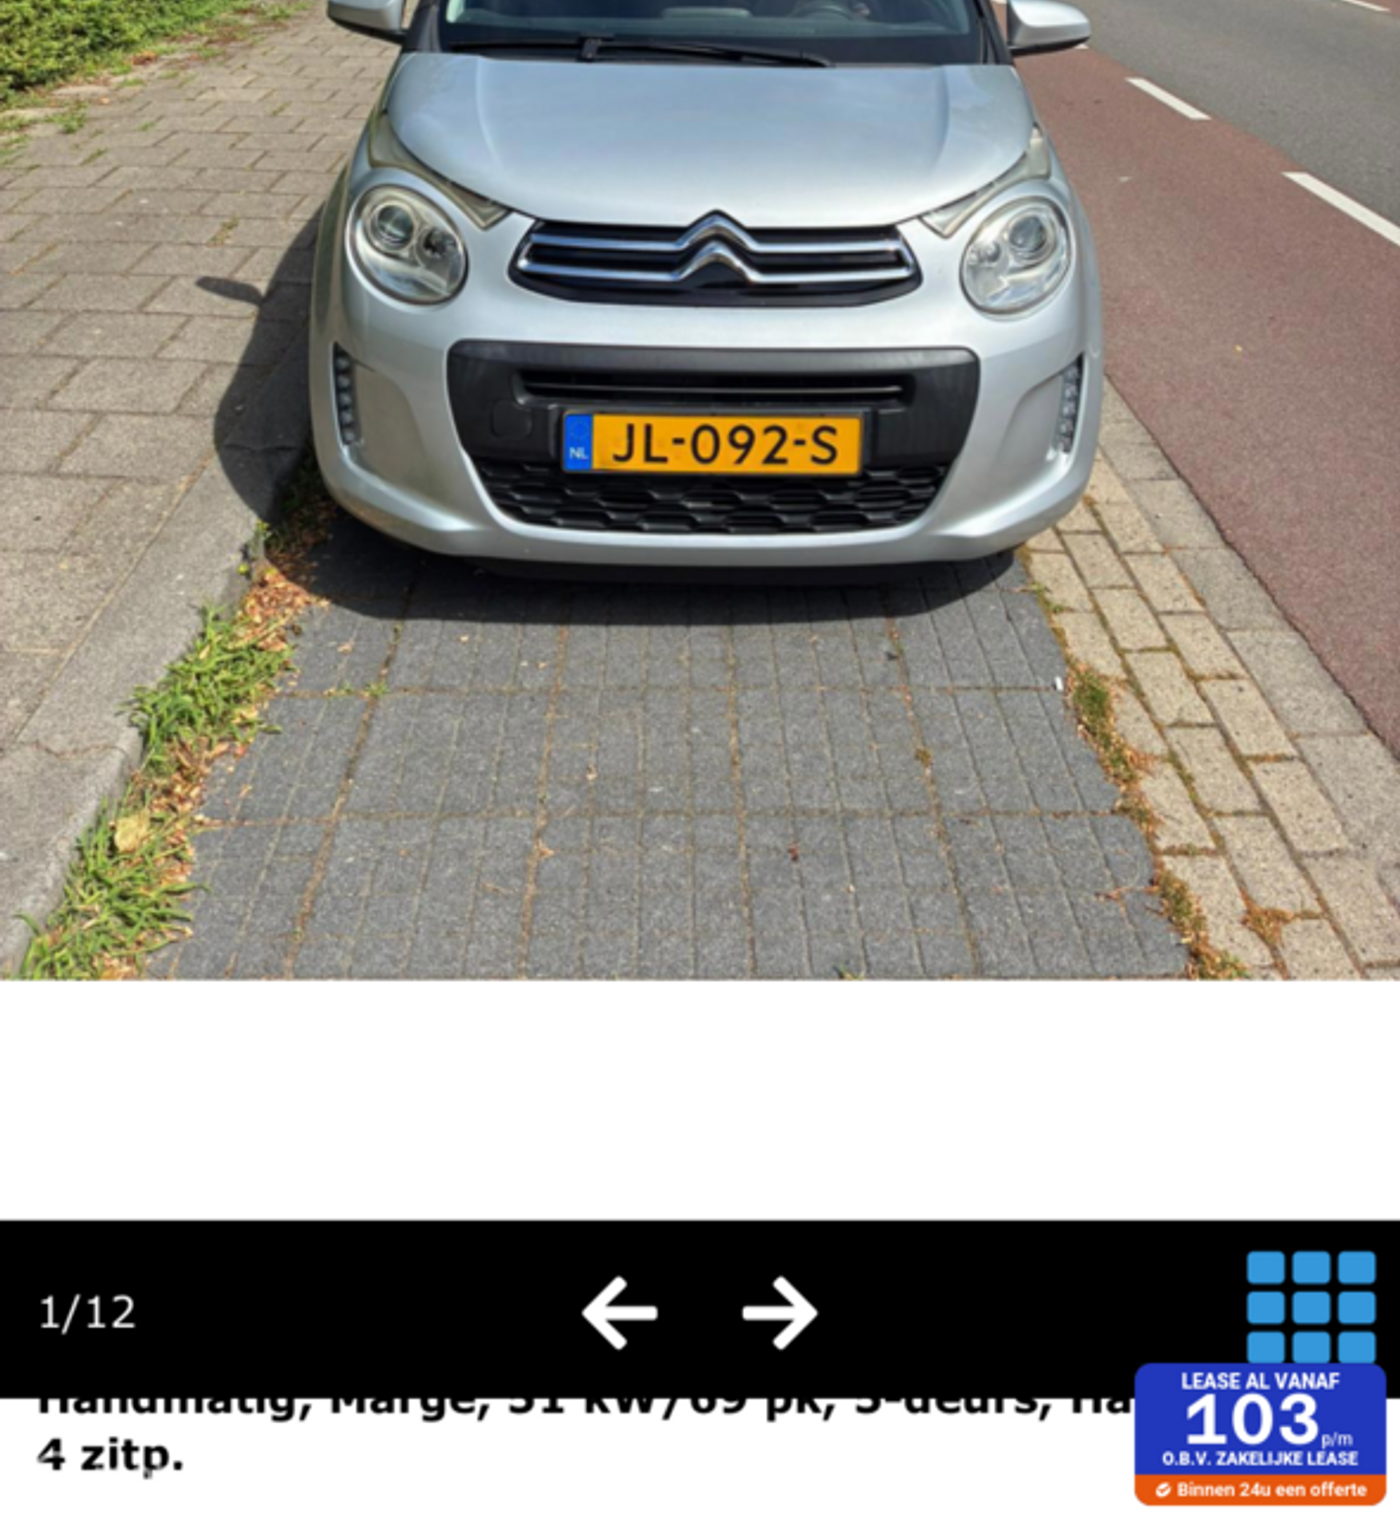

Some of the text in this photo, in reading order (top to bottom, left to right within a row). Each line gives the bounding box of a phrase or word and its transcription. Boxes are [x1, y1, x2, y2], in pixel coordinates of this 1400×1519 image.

[569, 447, 588, 459] NL
[612, 423, 838, 466] JL-092-S
[41, 1294, 136, 1335] 1/12
[37, 1436, 183, 1480] 4 zitp.
